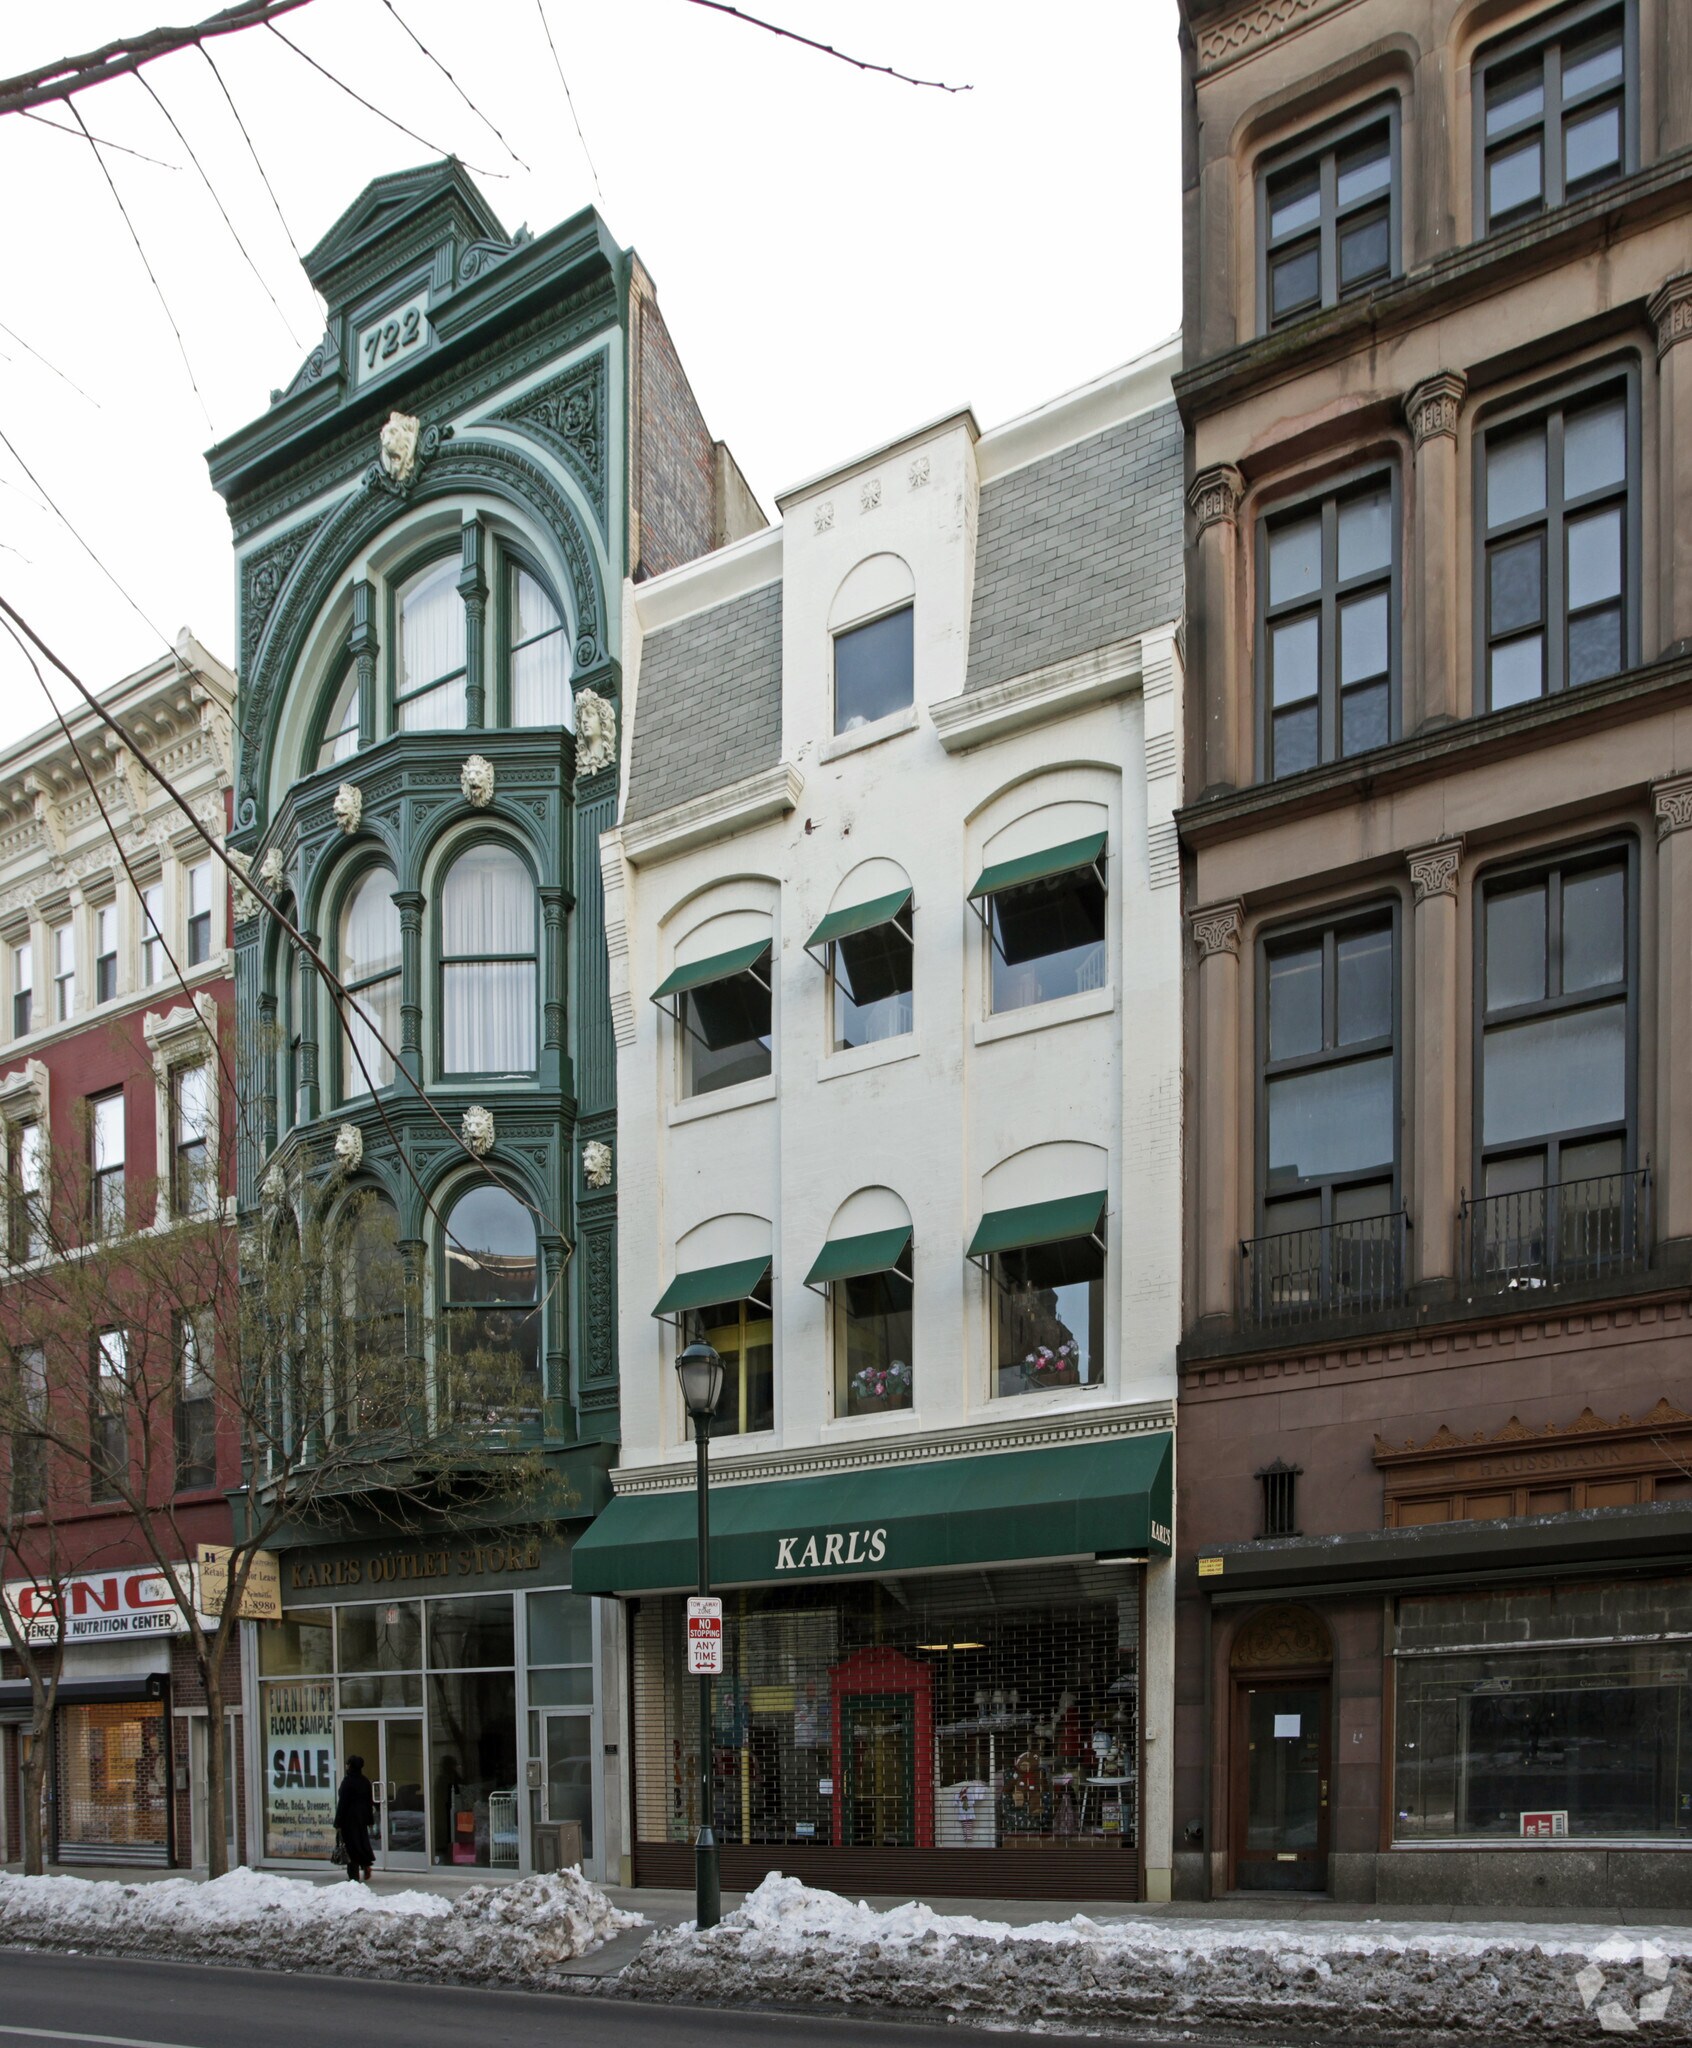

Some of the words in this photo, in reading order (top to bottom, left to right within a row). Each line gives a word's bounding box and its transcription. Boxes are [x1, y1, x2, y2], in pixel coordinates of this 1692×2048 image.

[364, 306, 420, 369] 722
[1480, 1447, 1621, 1476] HAUSSMANN
[1151, 1520, 1171, 1546] KARL'S
[775, 1528, 887, 1570] KARL'S
[204, 1567, 225, 1577] Retail
[259, 1571, 277, 1581] Lease
[291, 1559, 362, 1589] KARL'S
[367, 1552, 450, 1582] OUTLET
[457, 1545, 541, 1576] STORE
[73, 1617, 128, 1635] NUTRITION
[132, 1613, 171, 1631] CENTER
[690, 1629, 720, 1637] STOPPING
[698, 1619, 711, 1629] NO
[694, 1652, 717, 1660] TIME
[695, 1641, 716, 1650] ANY
[270, 1687, 333, 1713] FURNITURE
[271, 1716, 297, 1735] FLOOR
[300, 1715, 333, 1735] SAMPLE
[273, 1749, 330, 1789] SALE
